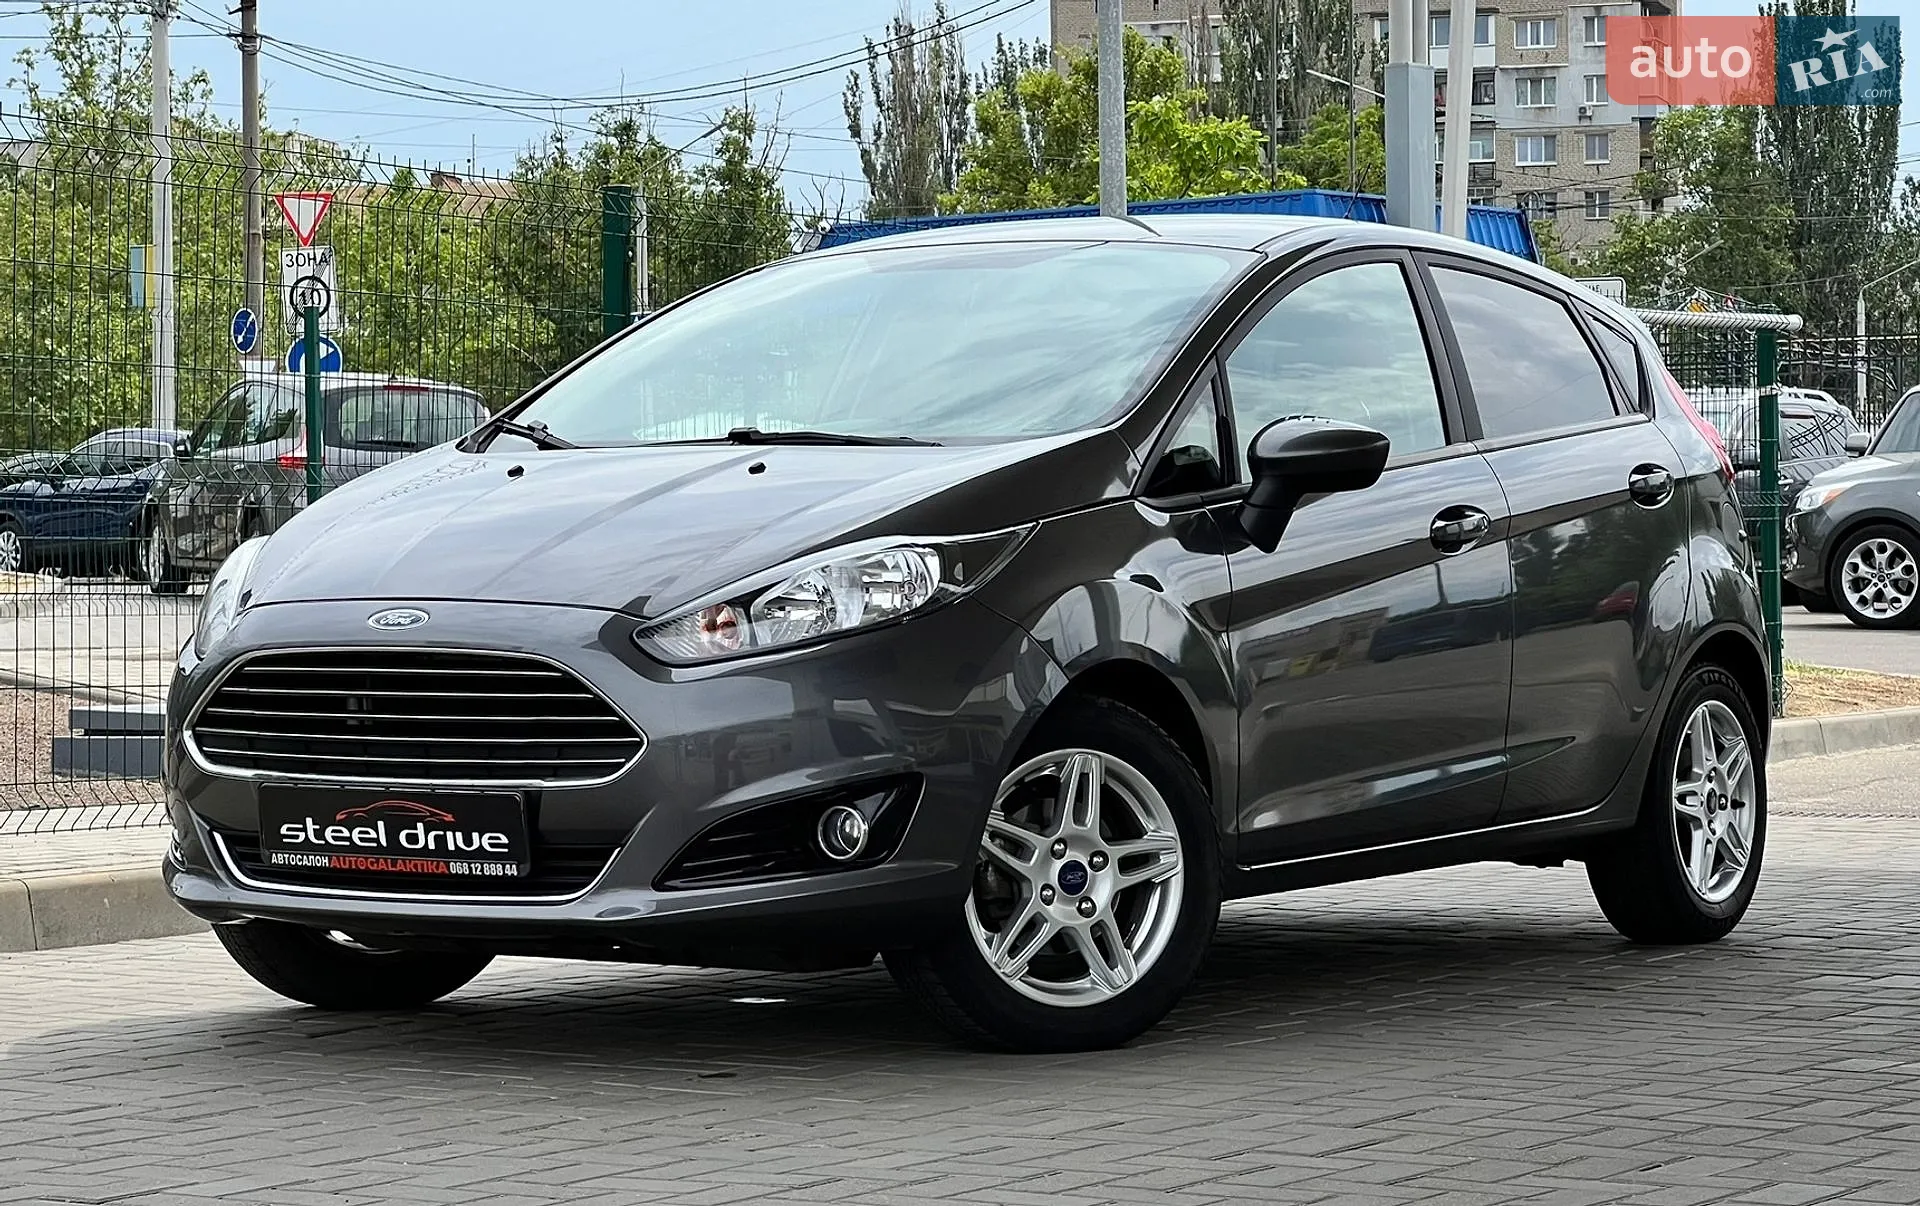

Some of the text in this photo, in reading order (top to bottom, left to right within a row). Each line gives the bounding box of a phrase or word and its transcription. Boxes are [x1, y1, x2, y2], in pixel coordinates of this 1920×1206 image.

[285, 252, 331, 267] ЗОНА
[379, 612, 416, 625] Ford
[280, 817, 509, 853] steel drive
[271, 853, 518, 876] АВТОСАЛОН AUTOGALAKTIKA 068 12 888 44
